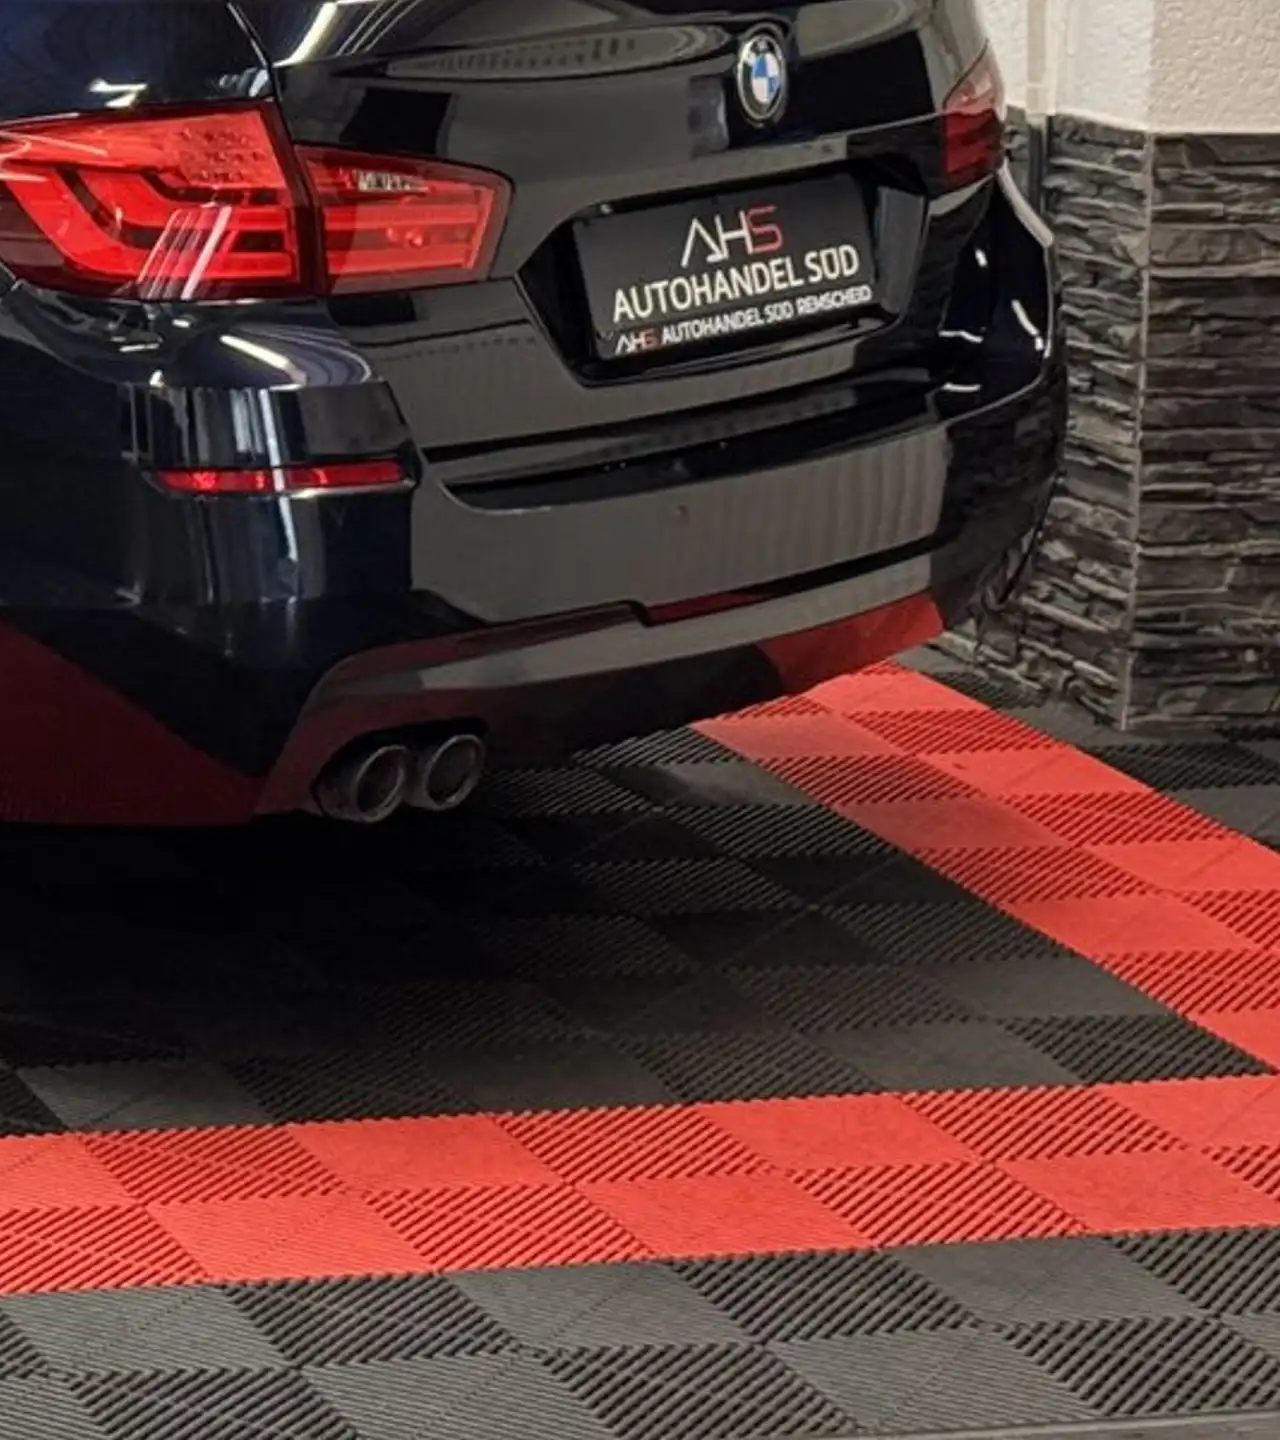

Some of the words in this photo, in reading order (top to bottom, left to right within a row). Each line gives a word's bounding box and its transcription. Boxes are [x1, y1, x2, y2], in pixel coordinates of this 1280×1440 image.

[681, 206, 782, 268] AHS
[613, 257, 803, 323] AUTOHANDEL
[804, 245, 859, 283] SÜD
[615, 328, 659, 355] AHS
[661, 308, 764, 345] AUTOHANDEL
[796, 284, 872, 314] REMSCHEID
